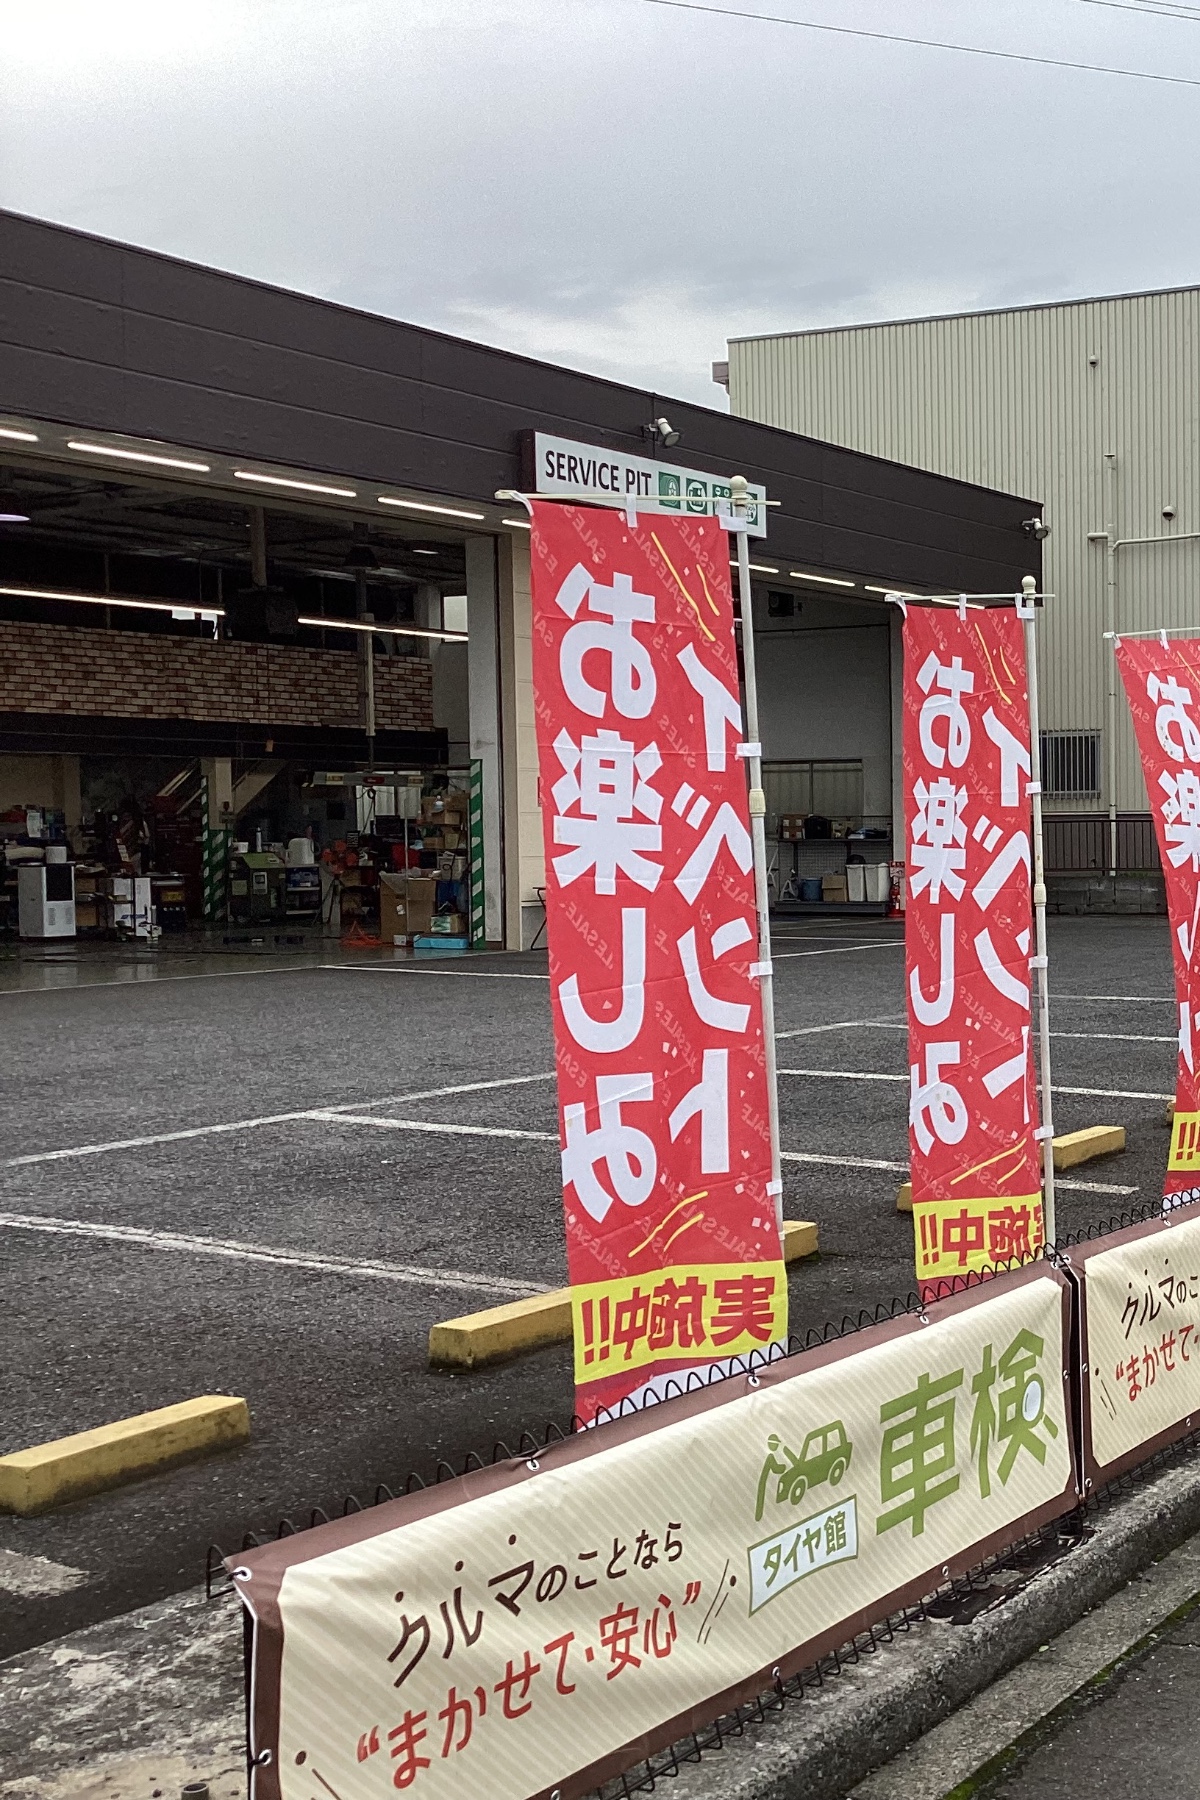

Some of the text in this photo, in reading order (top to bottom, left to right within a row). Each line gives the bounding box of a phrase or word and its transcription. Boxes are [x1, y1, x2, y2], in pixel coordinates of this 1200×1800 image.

[545, 450, 652, 496] SERVICE PIT
[876, 1328, 1059, 1538] 車検
[387, 1521, 684, 1688] クルマのことなら
[762, 1508, 850, 1582] タイヤ館
